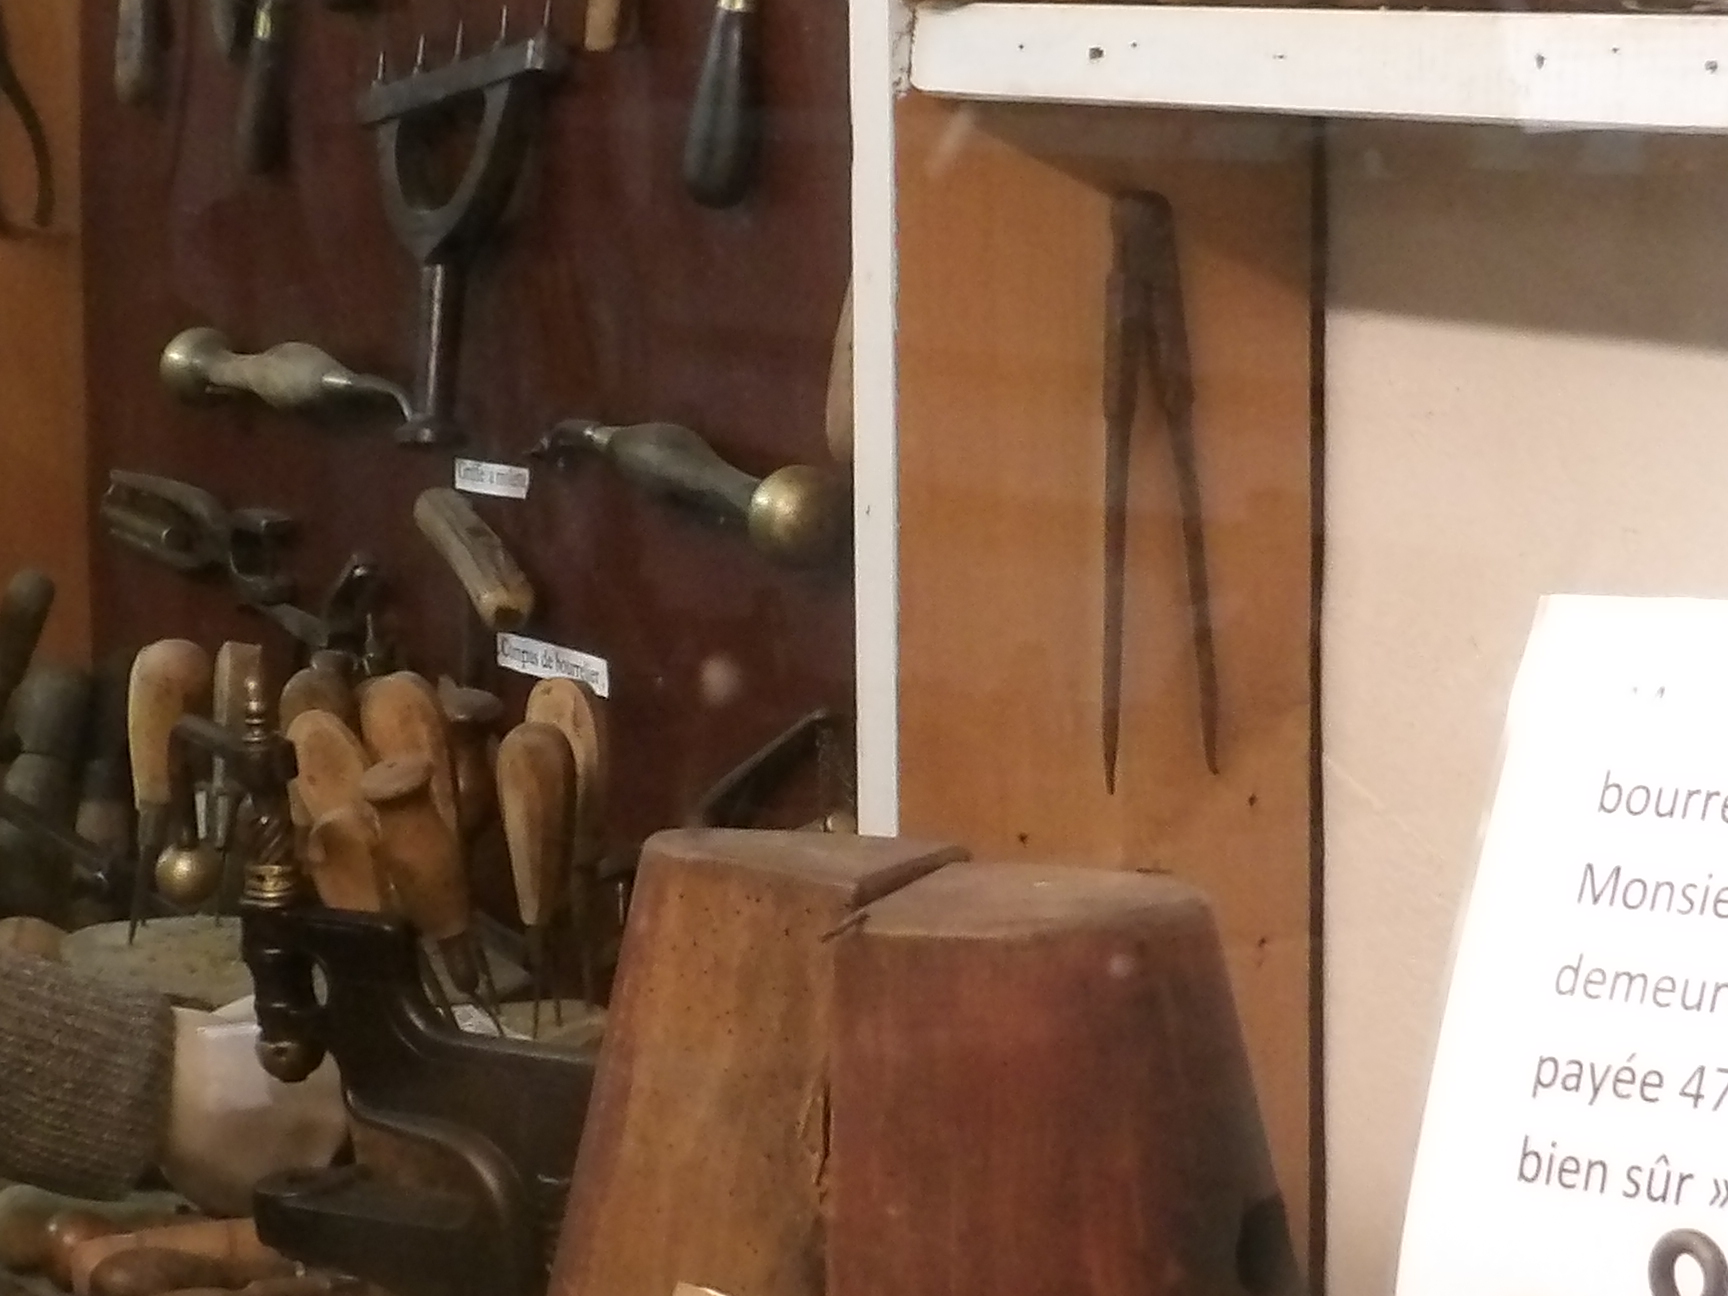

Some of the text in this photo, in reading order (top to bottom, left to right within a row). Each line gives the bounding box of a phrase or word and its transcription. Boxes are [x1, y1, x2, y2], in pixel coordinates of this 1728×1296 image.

[1531, 1052, 1665, 1107] payée
[1516, 1134, 1609, 1195] bien
[1621, 1153, 1695, 1206] sûr
